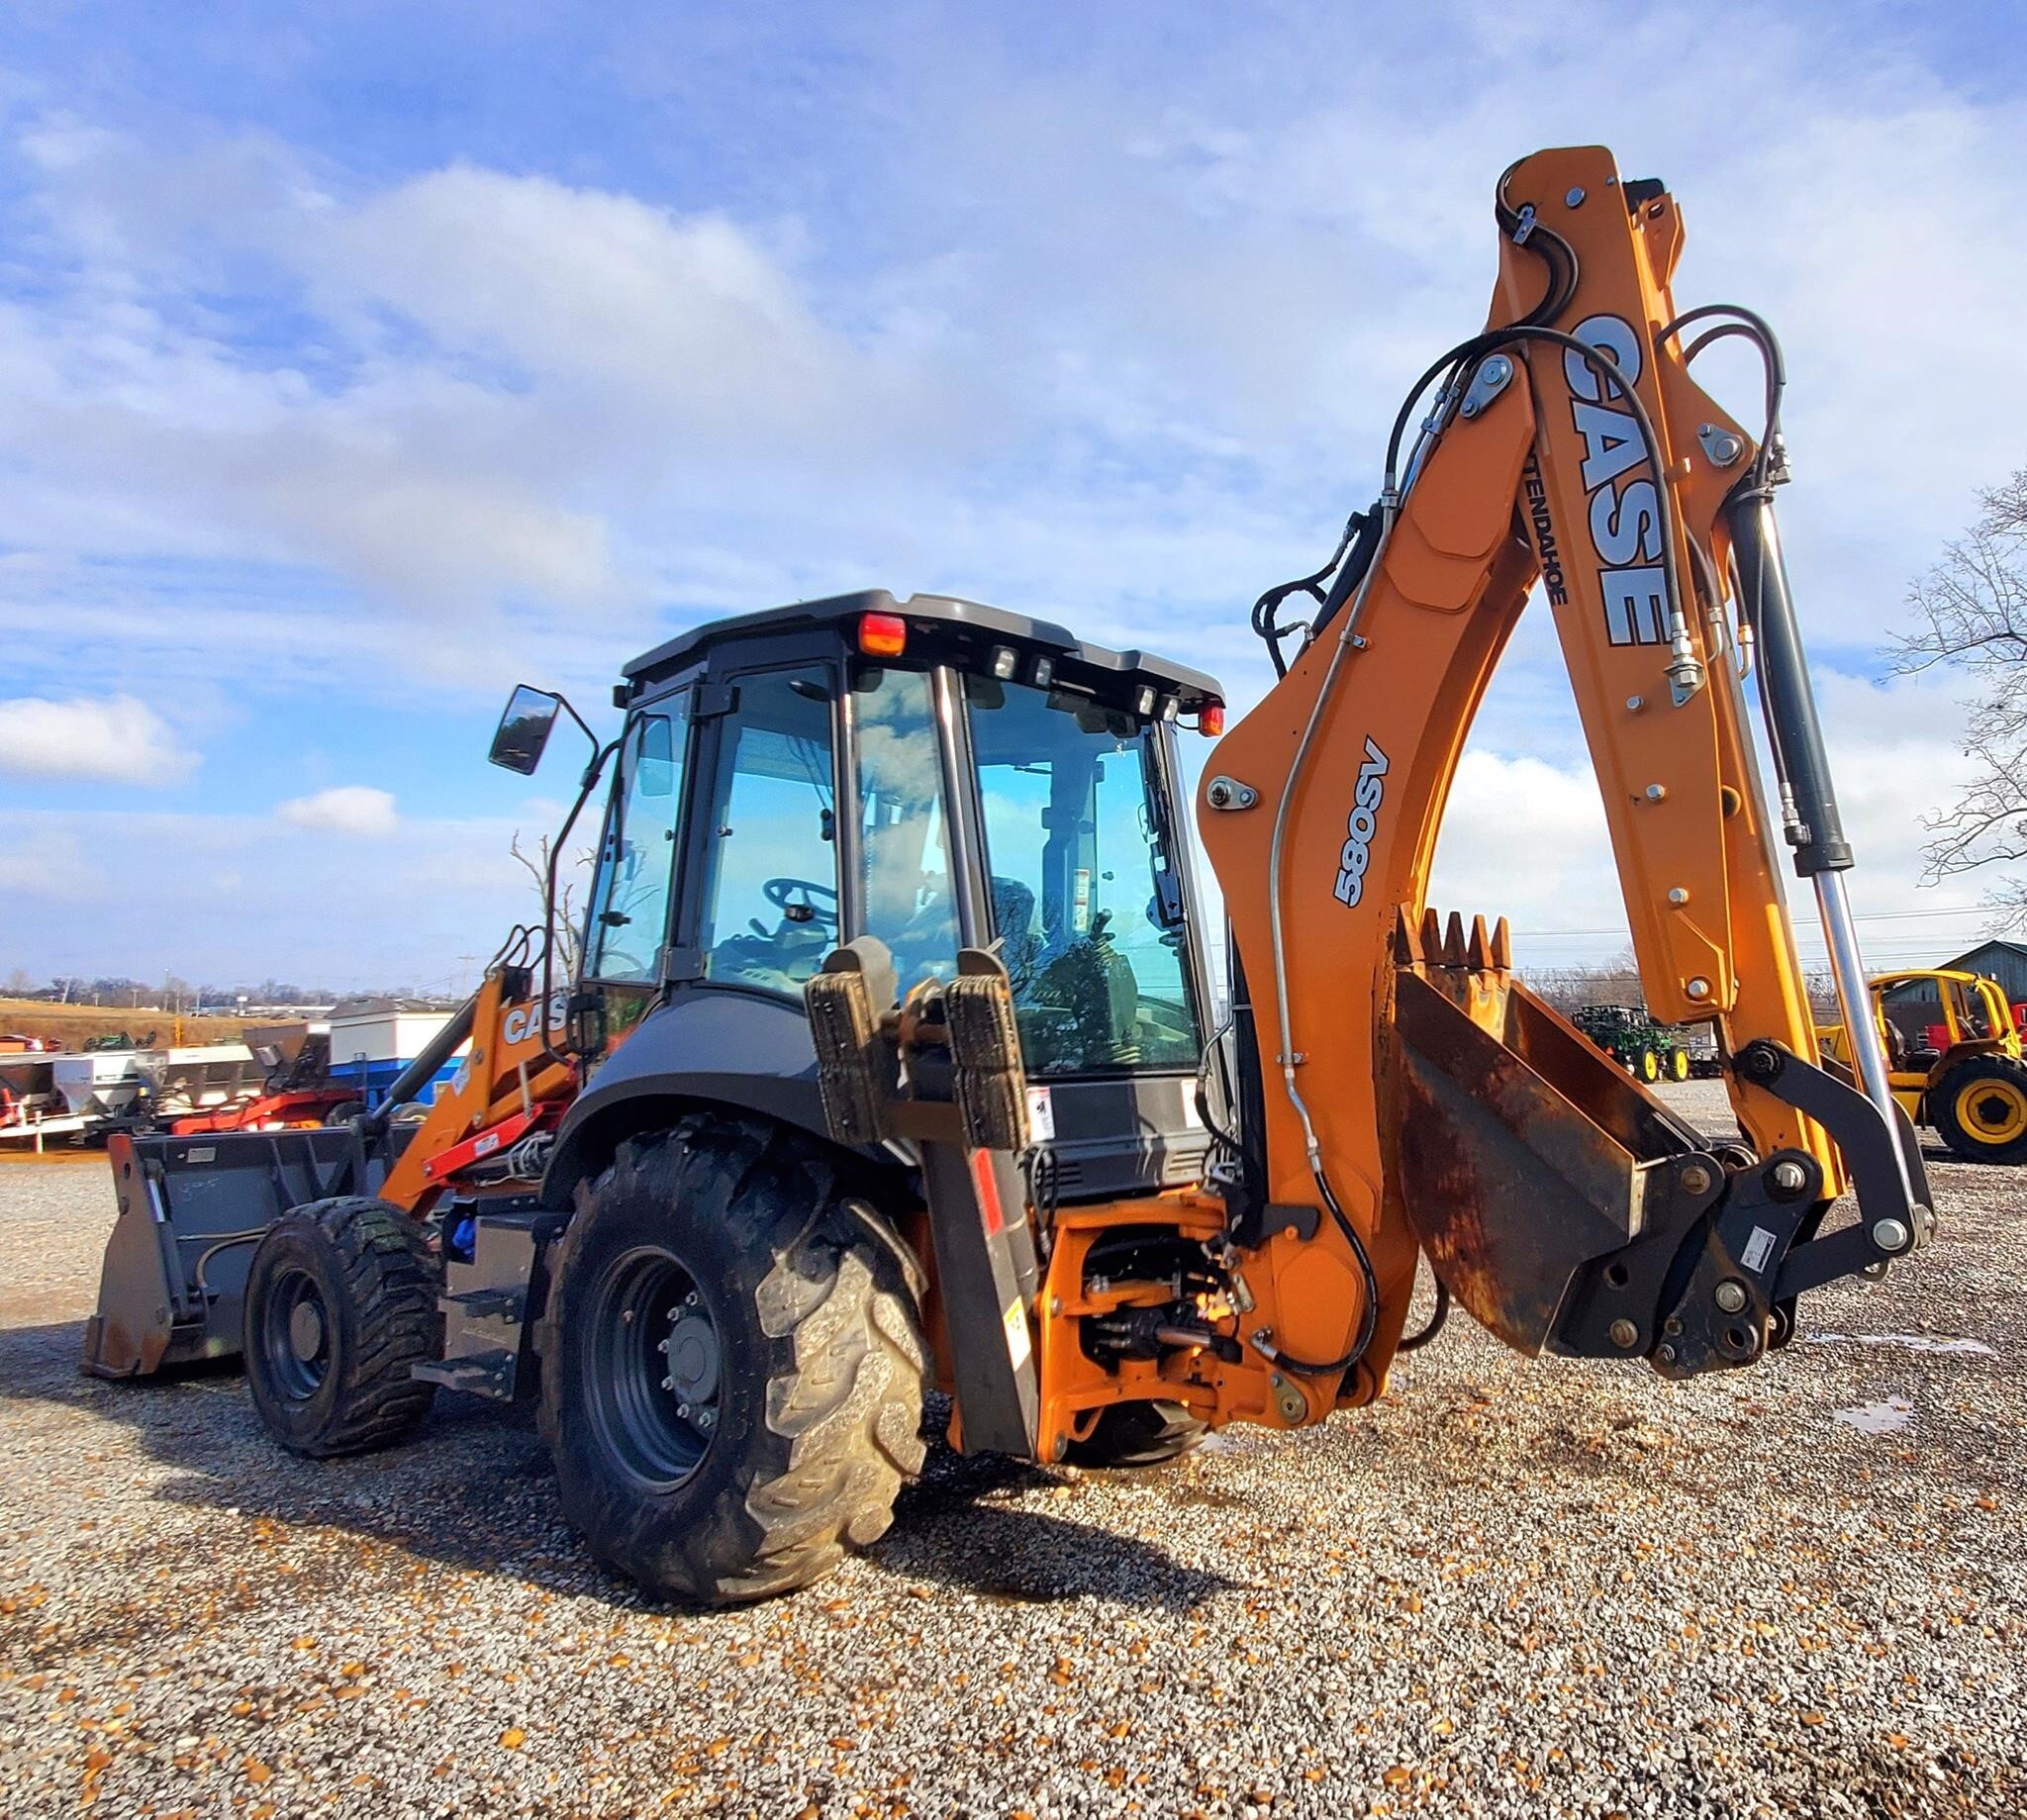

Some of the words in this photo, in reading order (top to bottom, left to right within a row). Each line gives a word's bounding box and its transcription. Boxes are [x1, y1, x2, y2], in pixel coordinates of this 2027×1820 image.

[1523, 447, 1569, 607] TENDAHOE
[1561, 313, 1675, 647] CASE
[1333, 734, 1391, 909] 580SV
[504, 995, 568, 1045] CAS
